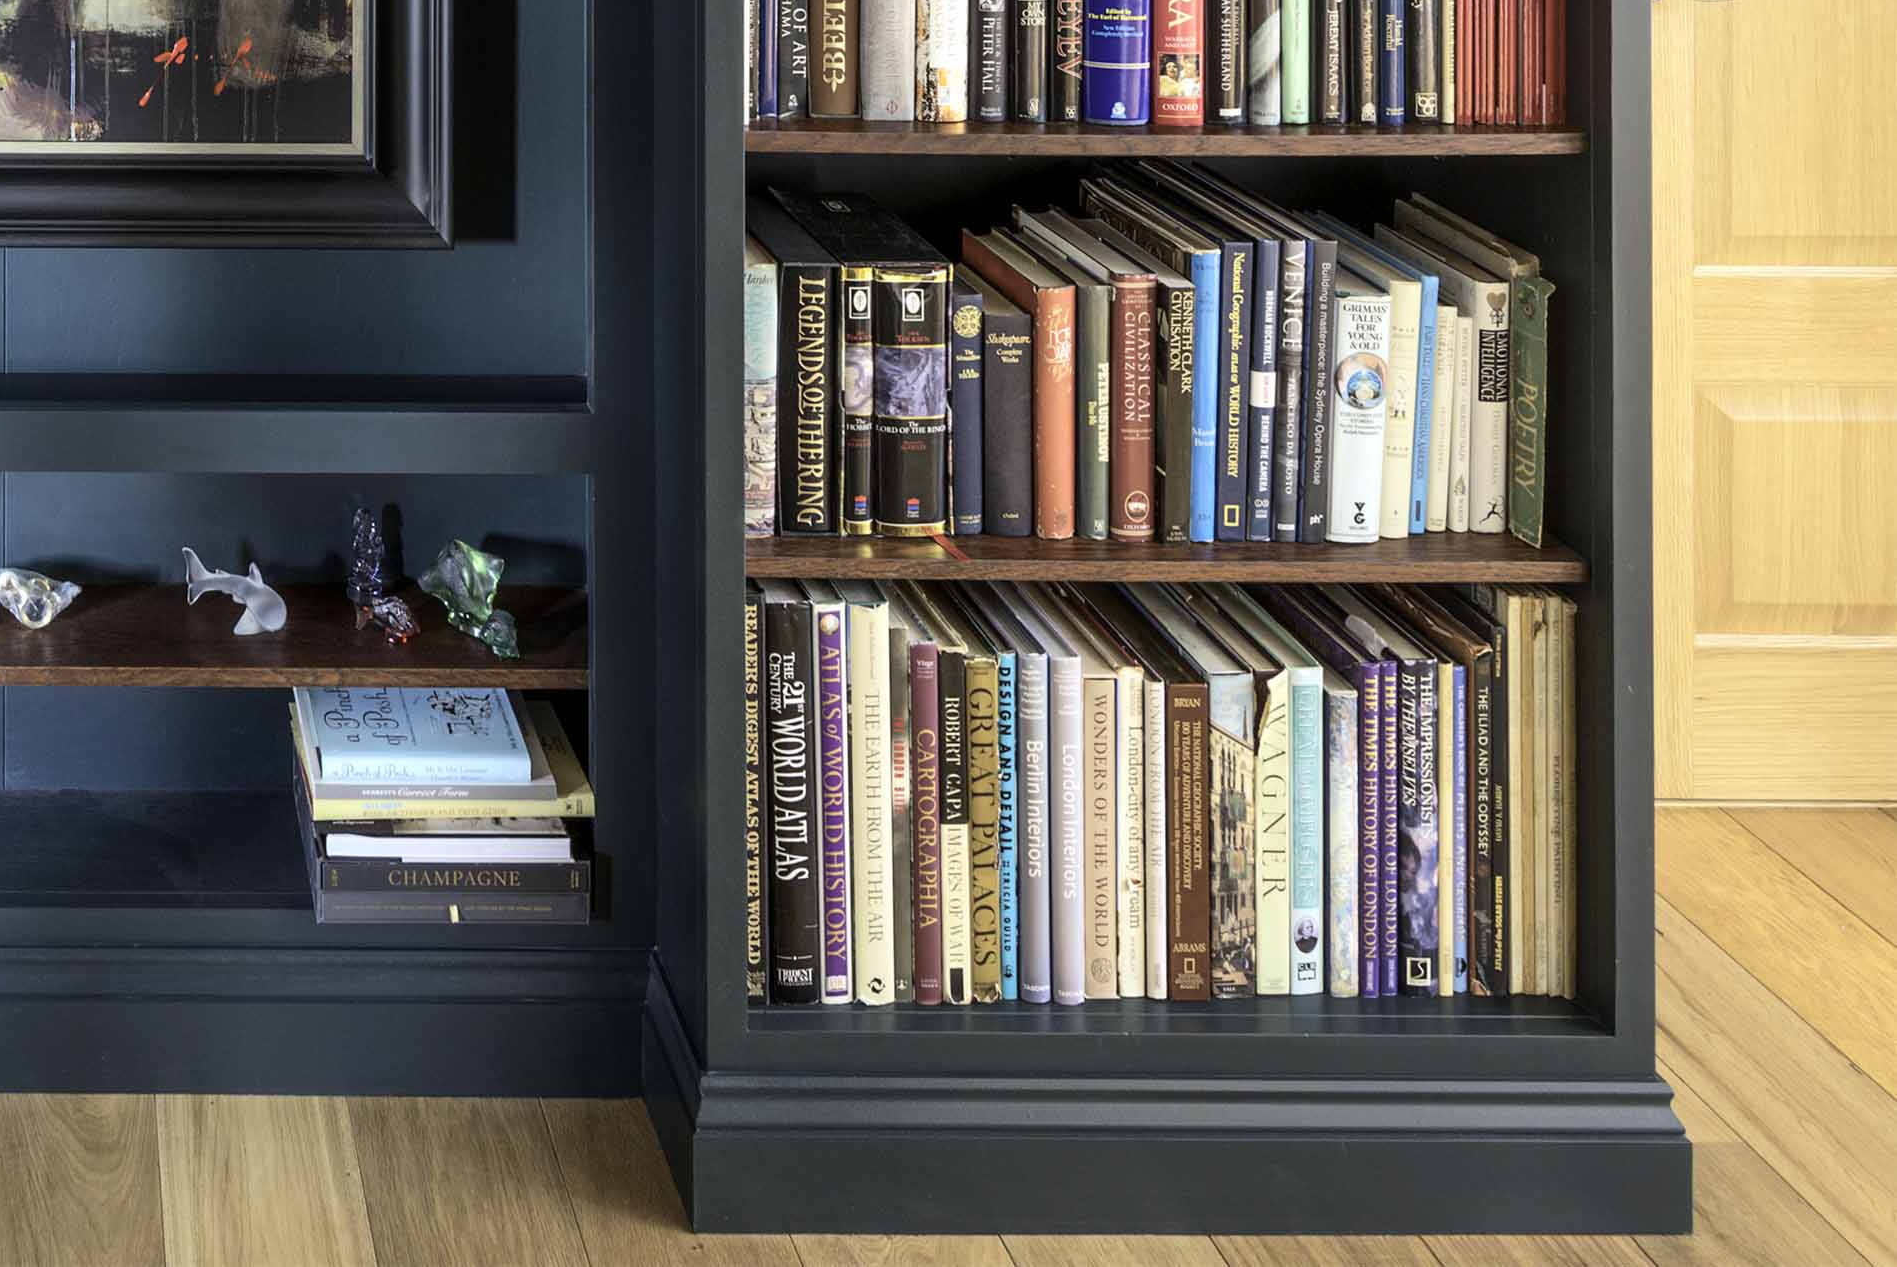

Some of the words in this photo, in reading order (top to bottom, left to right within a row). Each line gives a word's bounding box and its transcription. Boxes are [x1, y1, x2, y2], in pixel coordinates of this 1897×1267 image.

[794, 11, 806, 32] OF
[793, 41, 806, 78] ART
[798, 276, 826, 384] LEGENDS
[1170, 292, 1181, 371] CIVILISATION
[1182, 291, 1193, 348] KENNETH
[1283, 253, 1304, 352] VENICE
[1343, 304, 1387, 313] GRIMMS'
[1350, 314, 1383, 323] TALES
[1356, 324, 1375, 332] FOR
[1124, 311, 1135, 422] CIVILIZATION
[1137, 311, 1150, 422] CLASSICAL
[1348, 333, 1383, 341] YOUNG
[1357, 342, 1380, 350] OLD
[1480, 330, 1494, 402] INTELLIGENCE
[1495, 330, 1509, 402] EMOTIONAL
[797, 385, 825, 417] OF
[1181, 352, 1193, 393] CLARK
[797, 418, 824, 460] THE
[1514, 379, 1537, 497] POETRY
[797, 461, 824, 525] RING
[821, 646, 842, 718] ATLAS
[999, 666, 1011, 736] DESIGN
[1173, 697, 1201, 709] BRYAN
[1365, 677, 1377, 710] THE
[1403, 674, 1415, 693] BY
[1420, 674, 1432, 706] THE
[1478, 686, 1489, 710] THE
[827, 724, 840, 741] of
[945, 697, 961, 767] ROBERT
[969, 687, 996, 808] GREAT
[1094, 694, 1108, 789] WONDERS
[1365, 716, 1377, 772] TIMES
[1403, 698, 1417, 806] THEMSELVES
[1478, 714, 1489, 745] ILIAD
[772, 718, 808, 802] WORLD
[999, 742, 1013, 783] AND
[1025, 739, 1044, 792] Berlin
[1061, 745, 1082, 815] London
[1420, 712, 1436, 839] IMPRESSIONISTS
[1478, 748, 1489, 775] AND
[1478, 777, 1489, 801] THE
[822, 747, 844, 845] WORLD
[946, 775, 961, 820] CAPA
[999, 790, 1013, 854] DETAIL
[1094, 793, 1108, 819] OF
[1262, 702, 1287, 898] WAGNER
[1365, 777, 1377, 851] HISTORY
[773, 805, 809, 881] ATLAS
[915, 729, 939, 928] CARTOGRAPHIA
[1026, 797, 1043, 879] Interiors
[1094, 832, 1110, 871] THE
[1478, 802, 1489, 857] ODYSSEY
[388, 871, 520, 886] CHAMPAGNE
[1062, 818, 1079, 901] Interiors
[1365, 858, 1377, 878] OF
[824, 850, 846, 961] HISTORY
[971, 817, 996, 967] PALACES
[1094, 878, 1111, 949] WORLD
[1365, 883, 1377, 959] LONDON
[1173, 942, 1206, 953] ABRAMS
